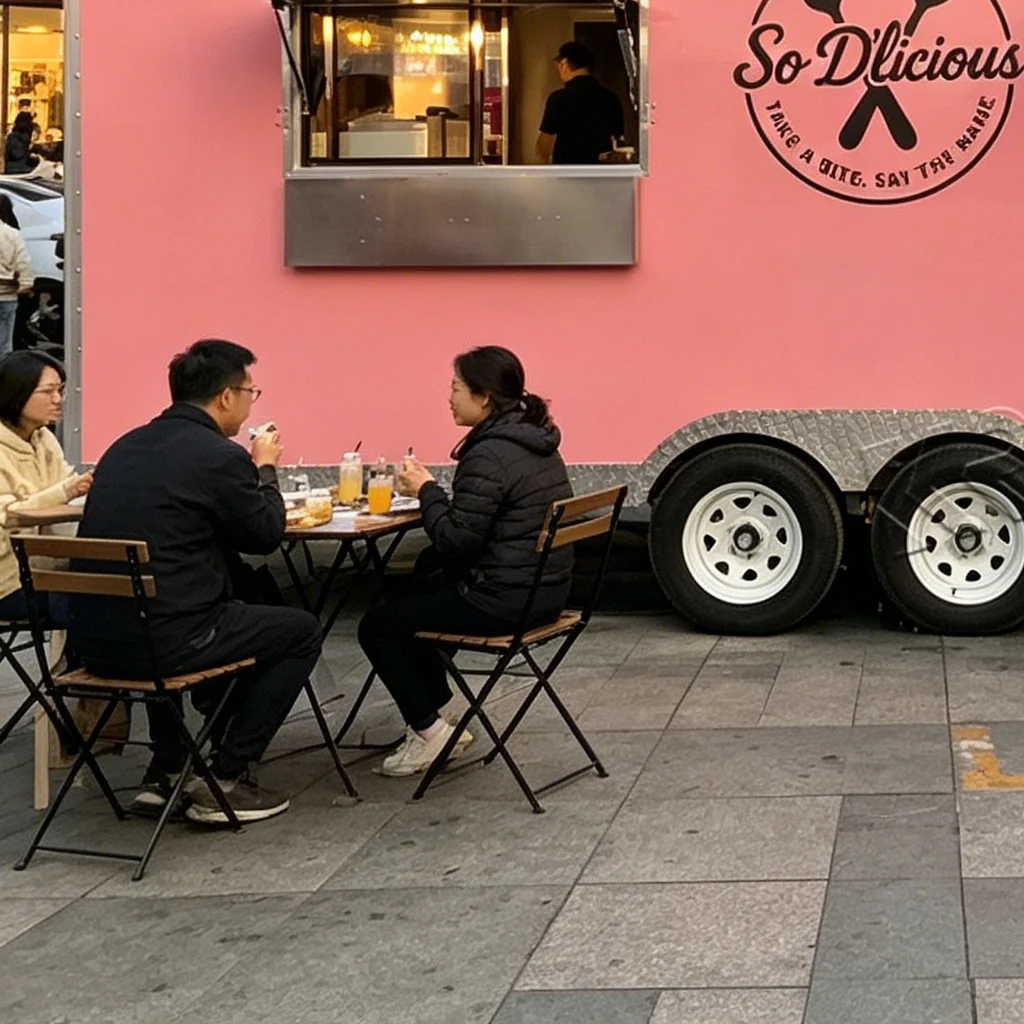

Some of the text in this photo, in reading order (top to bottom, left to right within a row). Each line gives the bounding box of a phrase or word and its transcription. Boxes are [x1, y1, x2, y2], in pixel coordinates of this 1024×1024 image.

[733, 23, 812, 89] So
[799, 149, 815, 164] A
[875, 171, 910, 188] SAY
